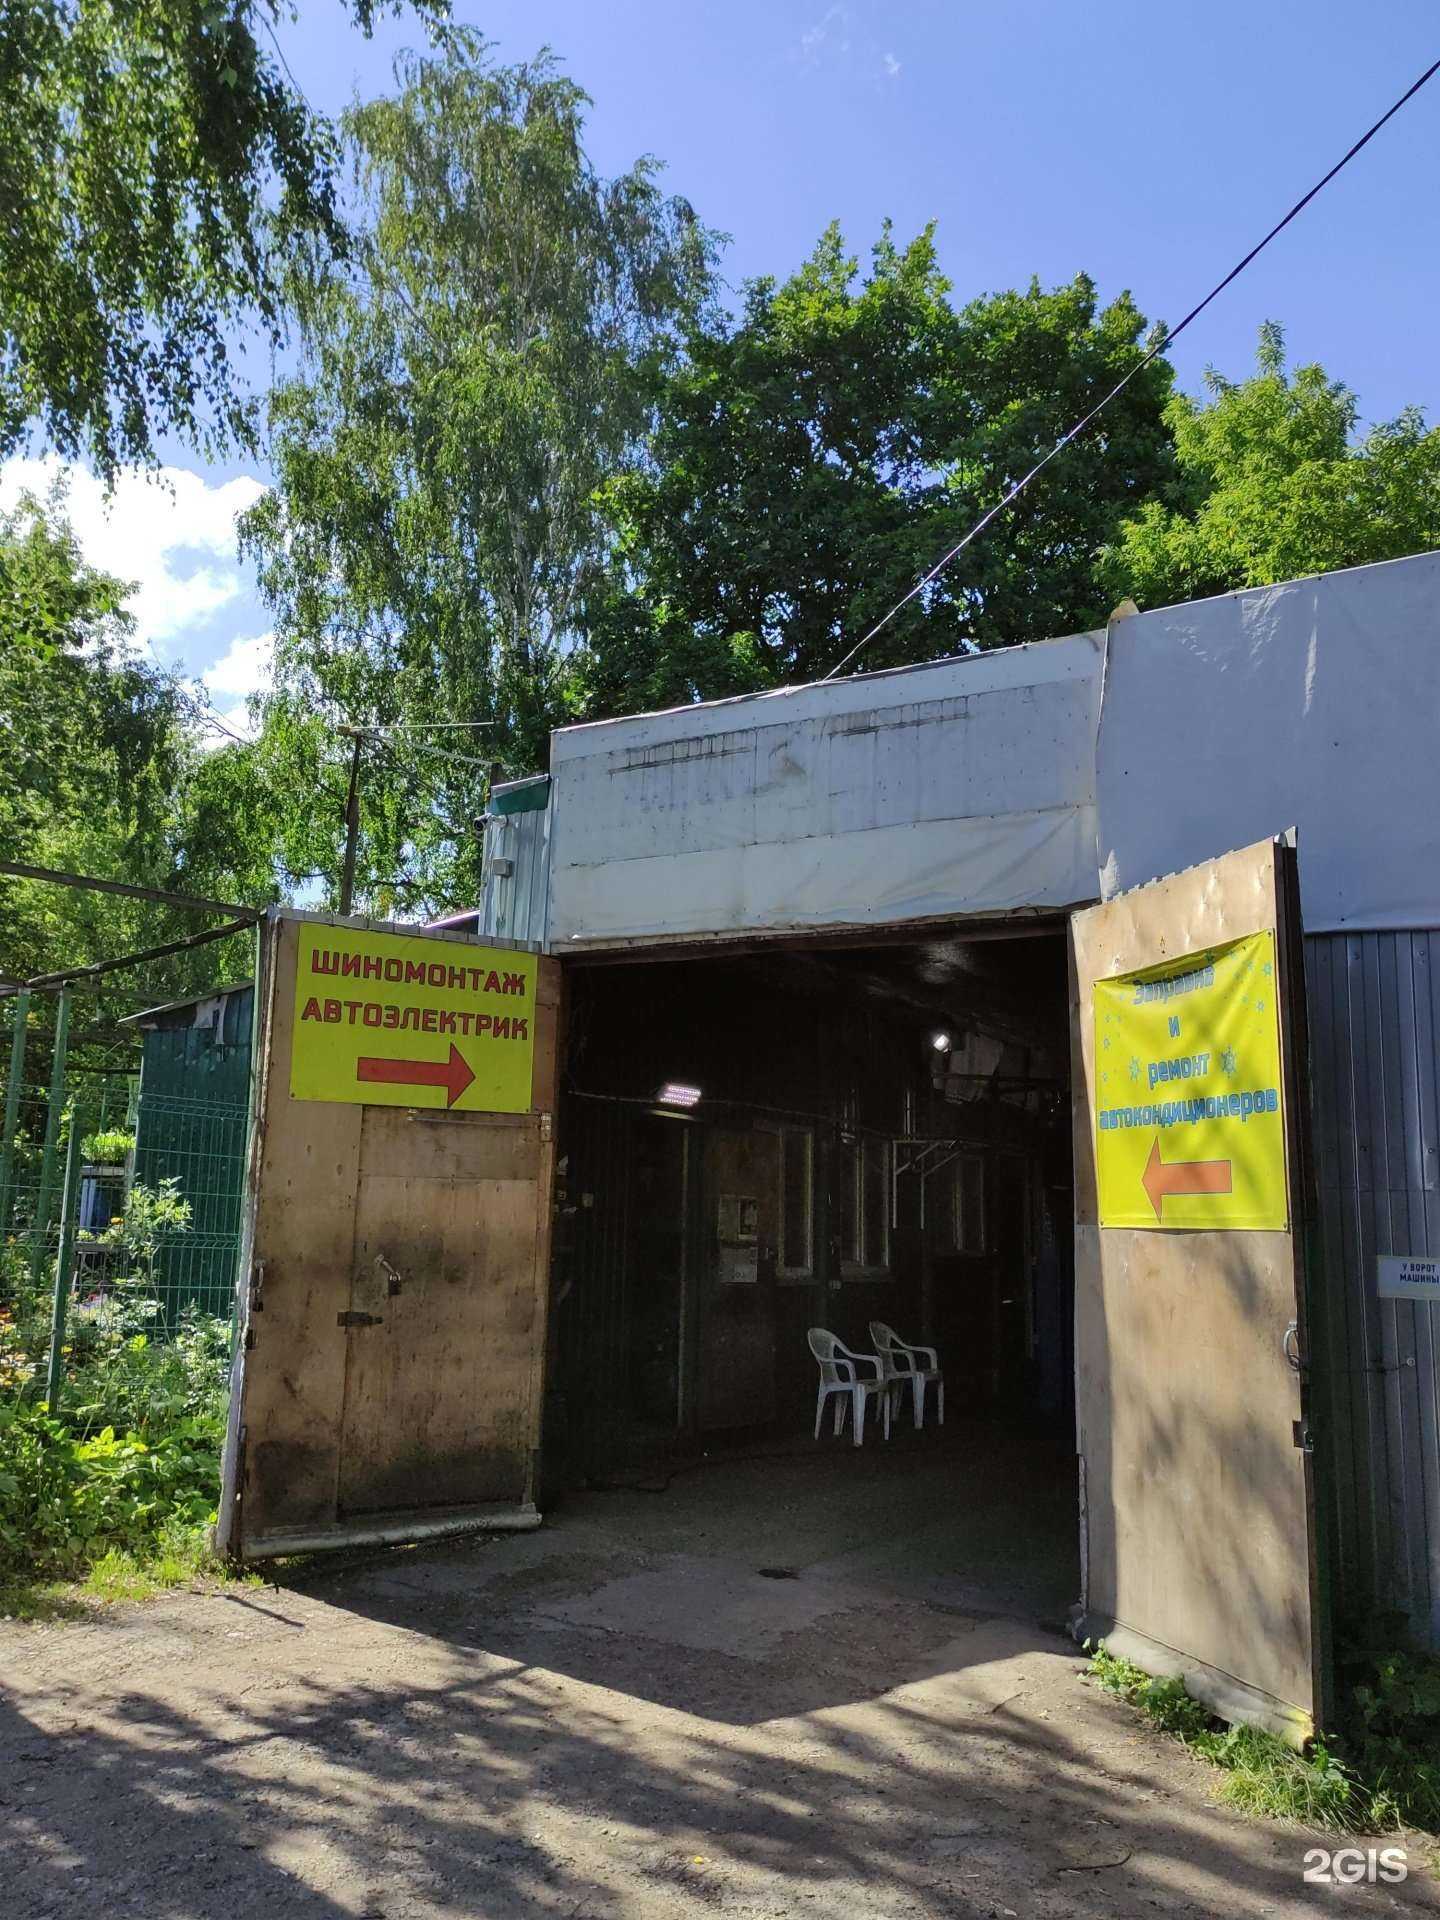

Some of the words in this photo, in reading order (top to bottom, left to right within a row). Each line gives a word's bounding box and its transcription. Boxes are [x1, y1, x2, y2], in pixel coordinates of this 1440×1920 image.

[311, 949, 526, 996] ШИНОМОНТАЖ
[301, 997, 528, 1040] АВТОЭЛЕКТРИК
[1148, 1053, 1211, 1090] ремонт
[1099, 1088, 1278, 1130] автокондиционеров
[1399, 1273, 1440, 1284] МАШИНЫ
[1402, 1263, 1408, 1271] У
[1410, 1263, 1436, 1273] ВОРОТ
